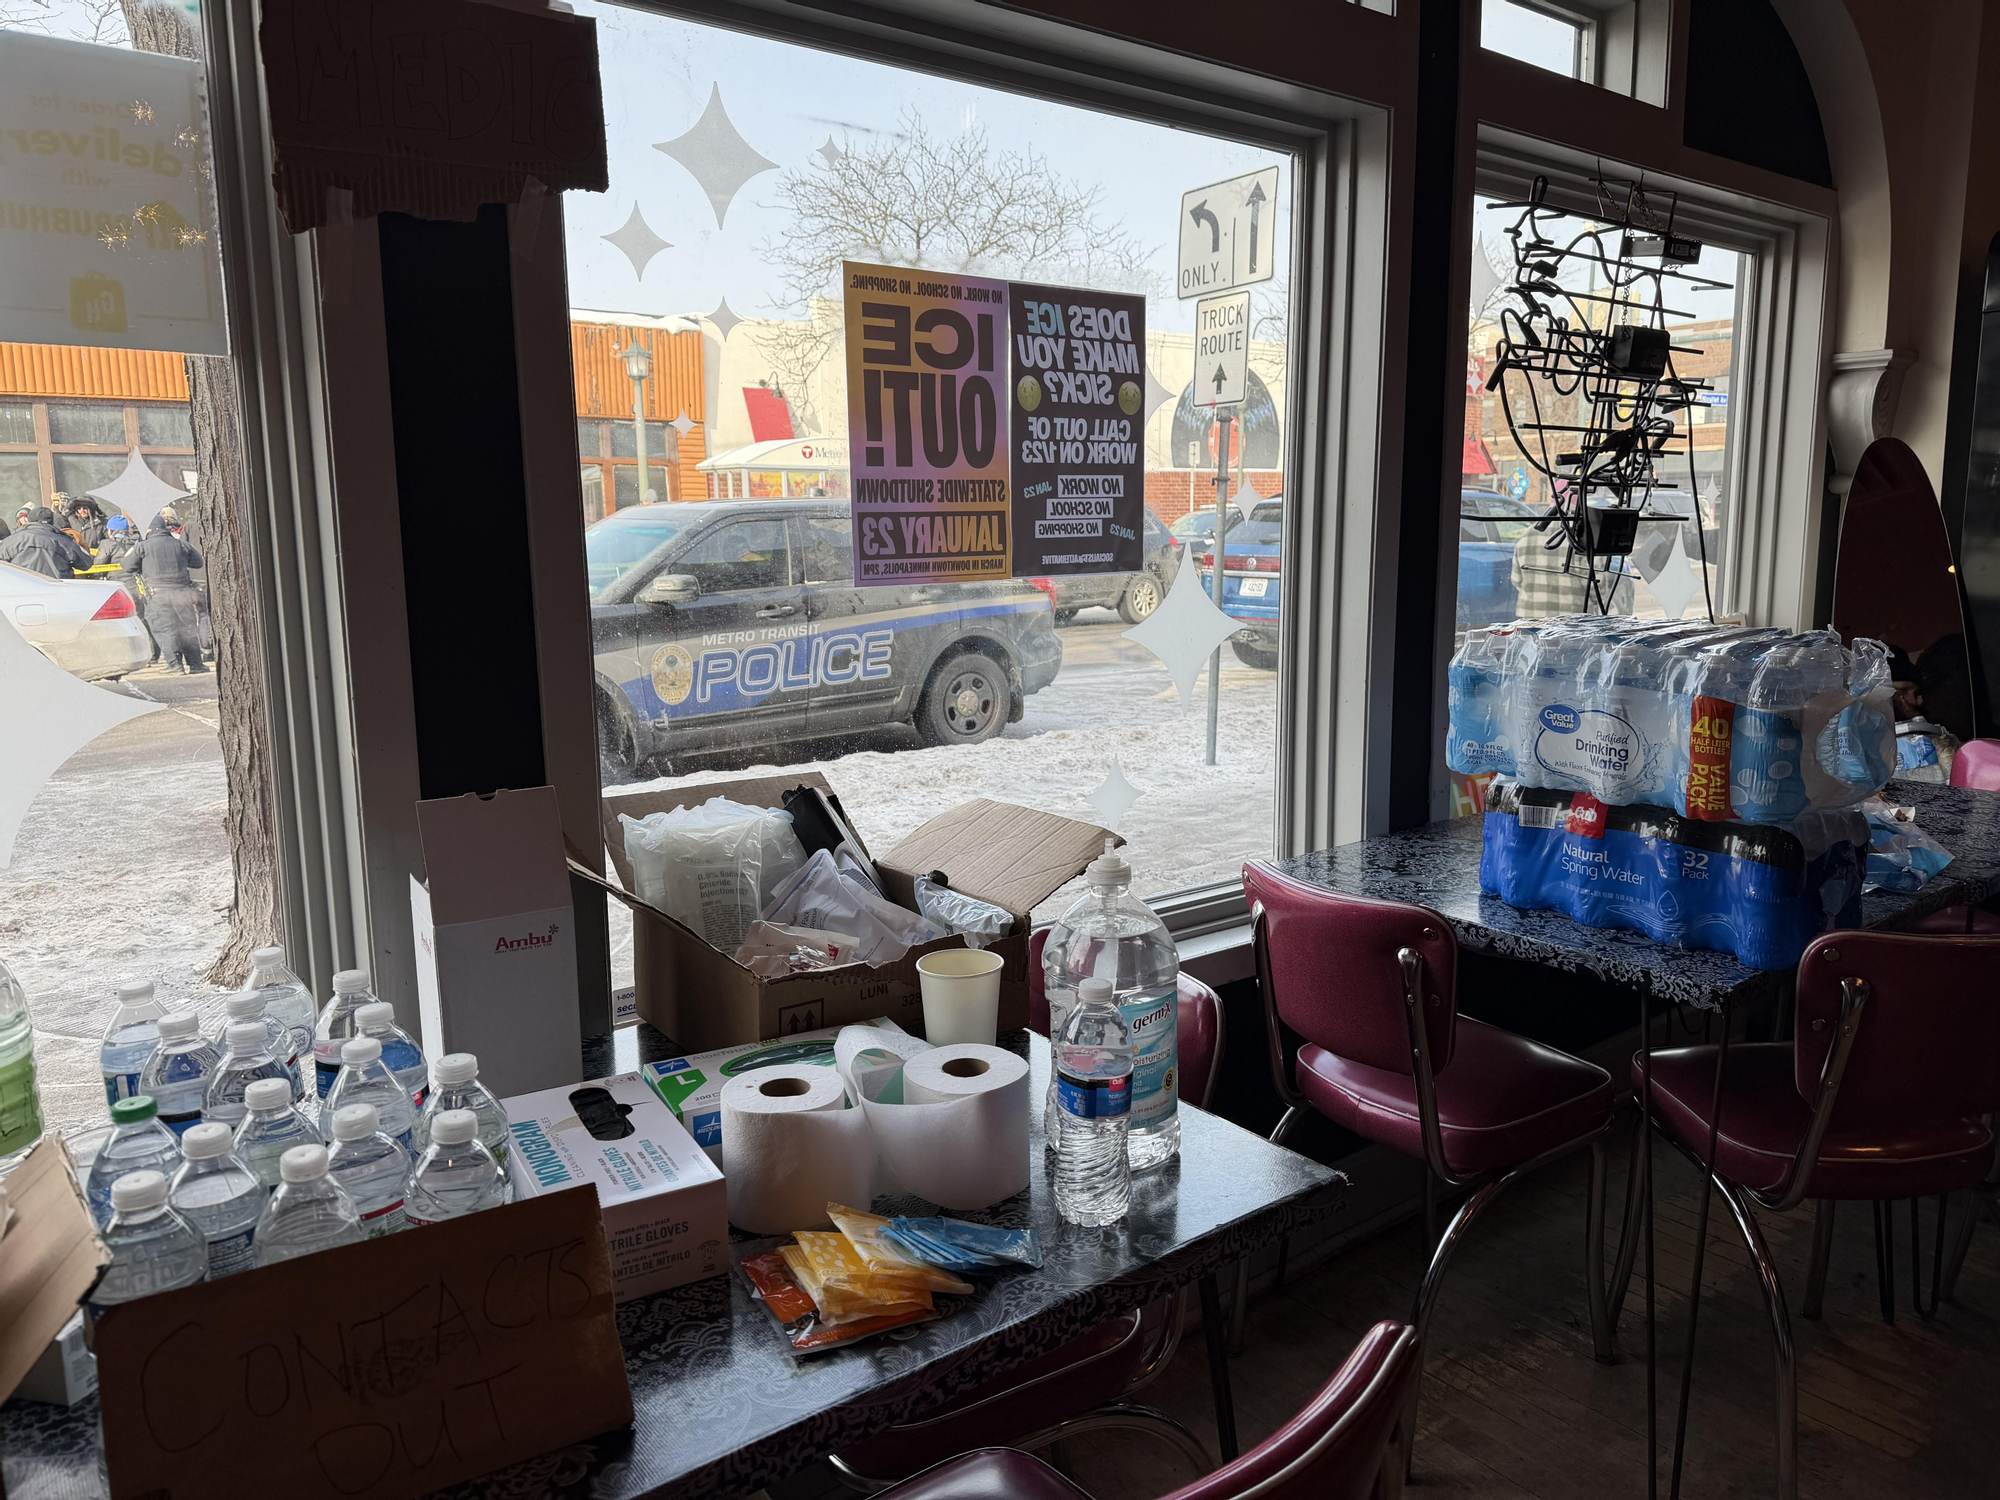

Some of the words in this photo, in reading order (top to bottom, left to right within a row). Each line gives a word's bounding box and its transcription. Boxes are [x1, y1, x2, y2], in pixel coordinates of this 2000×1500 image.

[291, 0, 597, 162] MEDIC
[1182, 261, 1219, 289] ONLY
[1202, 304, 1244, 331] TRUCK
[1201, 330, 1243, 356] ROUTE
[815, 446, 843, 459] Metro
[702, 630, 755, 647] METRO
[760, 623, 821, 640] TRANSIT
[697, 629, 894, 702] POLICE
[1544, 709, 1575, 724] Great
[1551, 719, 1575, 730] Value
[1595, 730, 1631, 746] Purified
[1692, 715, 1730, 741] 40
[1575, 738, 1630, 762] Drinking
[1691, 737, 1710, 747] HALF
[1711, 740, 1731, 749] LITER
[1694, 745, 1726, 756] BOTTLES
[1590, 754, 1629, 772] Water
[1689, 763, 1709, 810] PACK
[1708, 763, 1726, 811] VALUE
[1574, 805, 1598, 823] Cub
[1562, 842, 1609, 864] Natural
[1682, 851, 1710, 870] 32
[1561, 857, 1599, 880] Spring
[1600, 865, 1645, 886] Water
[1682, 867, 1710, 880] Pack
[699, 879, 731, 890] Chloride
[700, 888, 735, 898] Injection
[495, 932, 553, 951] Ambu
[692, 1045, 758, 1061] AloeTouch
[1133, 1049, 1171, 1066] oisturizing
[675, 1075, 697, 1085] L
[1133, 1066, 1157, 1079] iginal
[695, 1094, 712, 1102] 200
[696, 1122, 722, 1135] MEDLIN
[509, 1120, 572, 1187] MONOGRAM
[602, 1147, 628, 1168] GLOVES
[616, 1168, 643, 1191] NITRILE
[610, 1233, 642, 1251] TRILE
[645, 1221, 689, 1242] GLOVES
[612, 1263, 640, 1279] ANTES
[643, 1260, 654, 1271] DE
[656, 1250, 691, 1267] NITRILO
[140, 1236, 593, 1453] CONTACTS
[311, 1362, 521, 1495] OUT
